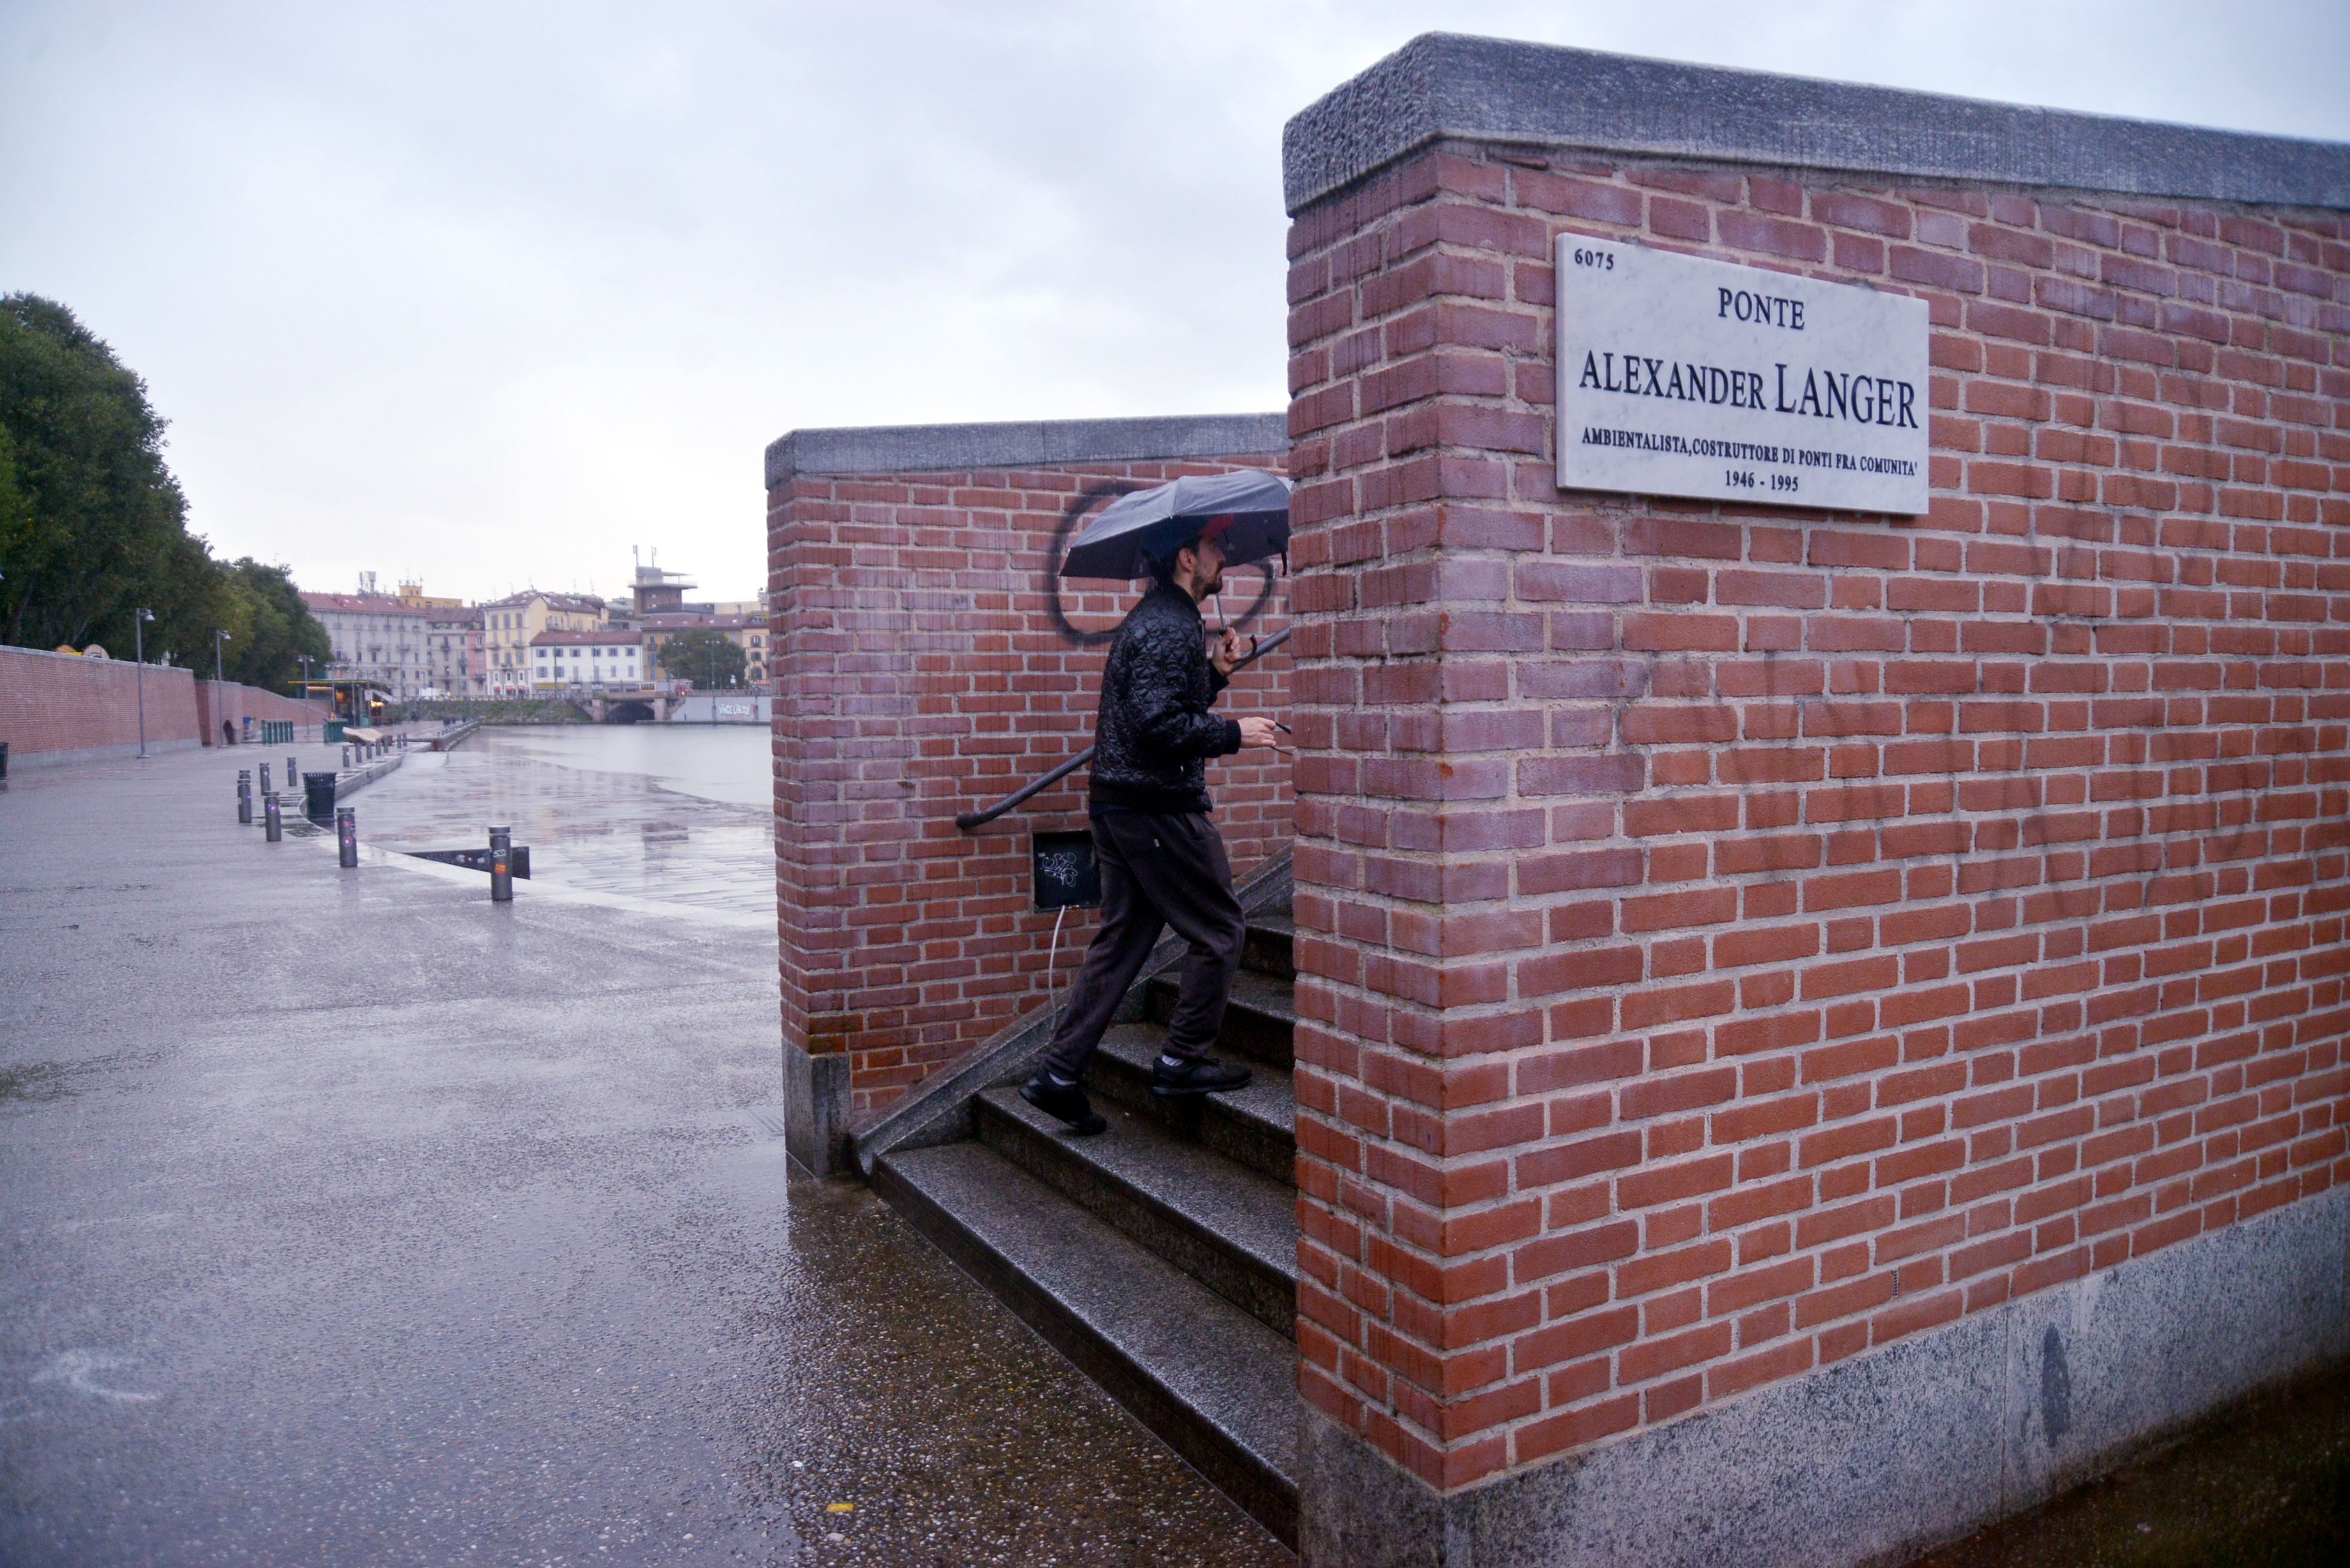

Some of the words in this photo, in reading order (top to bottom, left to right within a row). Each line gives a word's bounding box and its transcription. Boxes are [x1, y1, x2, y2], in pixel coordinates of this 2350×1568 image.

[1574, 248, 1614, 271] 6075
[1718, 287, 1805, 330] PONTE
[1579, 349, 1767, 410] ALEXANDER
[1775, 363, 1919, 429] LANGER
[1782, 448, 1796, 464] DI
[1798, 449, 1832, 468] PONTI
[1836, 454, 1857, 471] FRA
[1860, 456, 1917, 476] COMUNITA'
[1725, 470, 1755, 488] 1946
[1771, 474, 1799, 492] 1995
